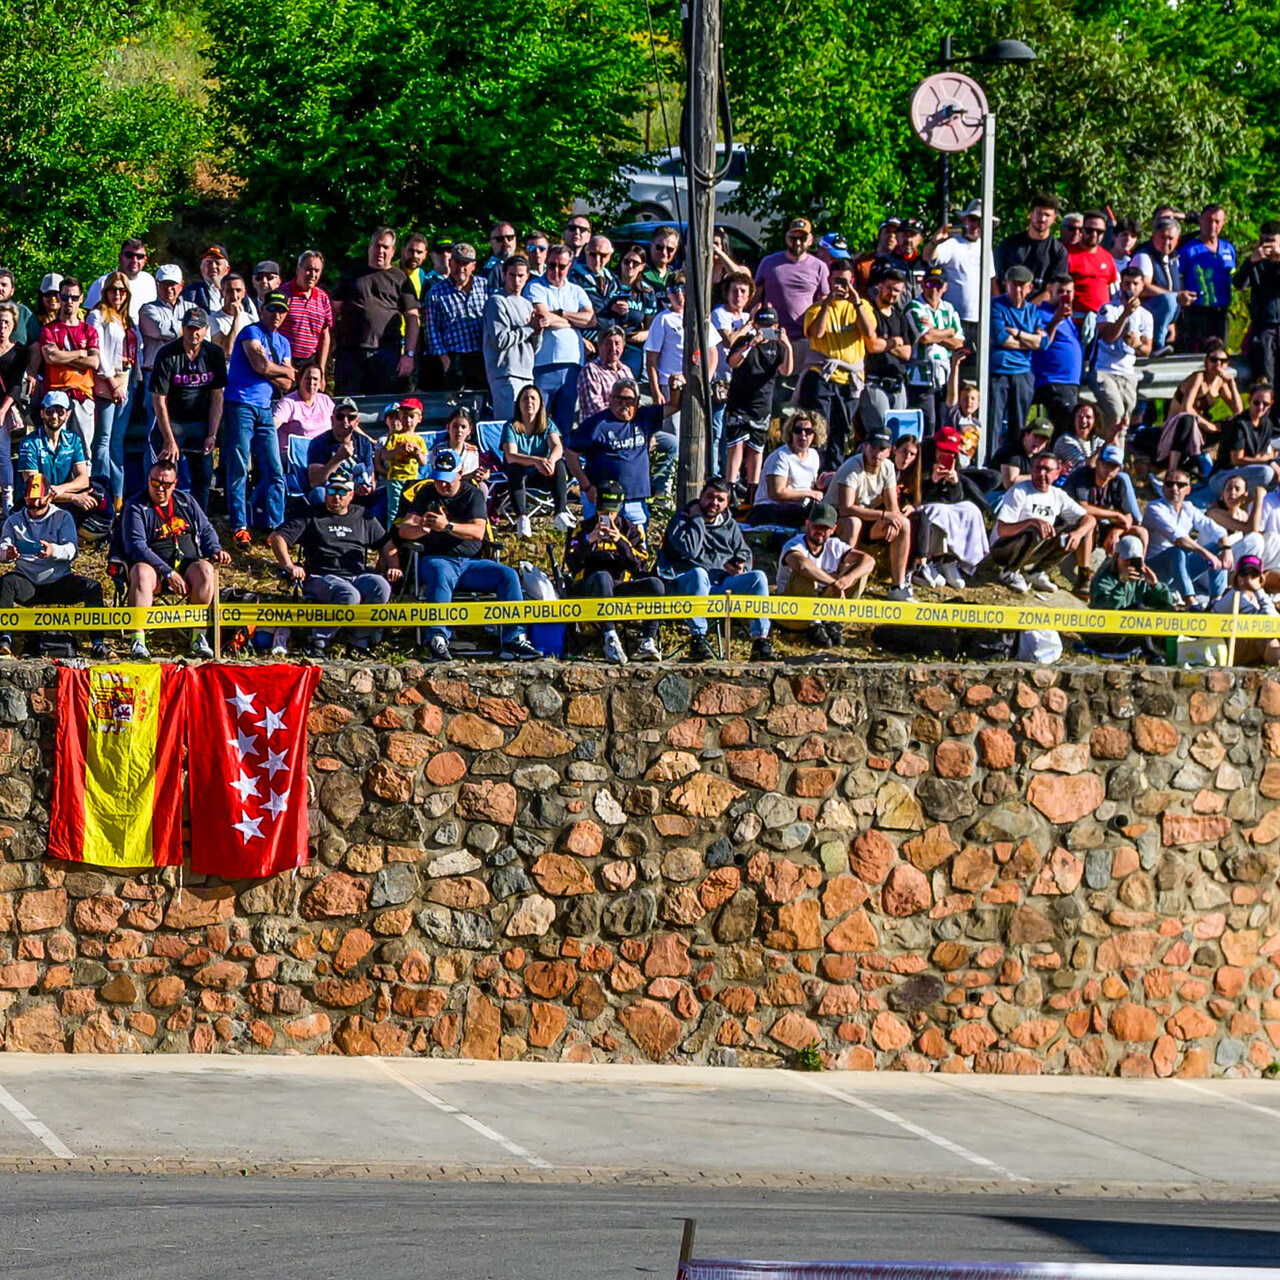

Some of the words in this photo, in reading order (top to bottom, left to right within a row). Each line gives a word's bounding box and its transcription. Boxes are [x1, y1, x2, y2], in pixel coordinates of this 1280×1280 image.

[34, 613, 72, 627] ZONA
[74, 612, 132, 626] PUBLICO
[146, 611, 181, 624] ZONA
[184, 608, 241, 622] PUBCO
[256, 608, 293, 622] ZONA
[296, 608, 355, 622] PUBLICO
[370, 608, 407, 622] ZONA
[410, 607, 469, 621] PUBLICO
[484, 606, 521, 619] ZONA
[523, 604, 582, 618] PUBLICO
[596, 603, 633, 617] ZONA
[636, 601, 693, 615] PUBLICO
[707, 600, 742, 613] ZONA
[745, 601, 799, 615] PUBLICO
[812, 602, 847, 617] ZONA
[849, 605, 902, 620] PUBLICO
[915, 606, 949, 621] ZONA
[951, 608, 1005, 623] PUBLICO
[1018, 611, 1052, 625] ZONA
[1054, 613, 1107, 628] PUBLICO
[1120, 615, 1154, 630] ZONA
[1156, 616, 1208, 632] PUBLICO
